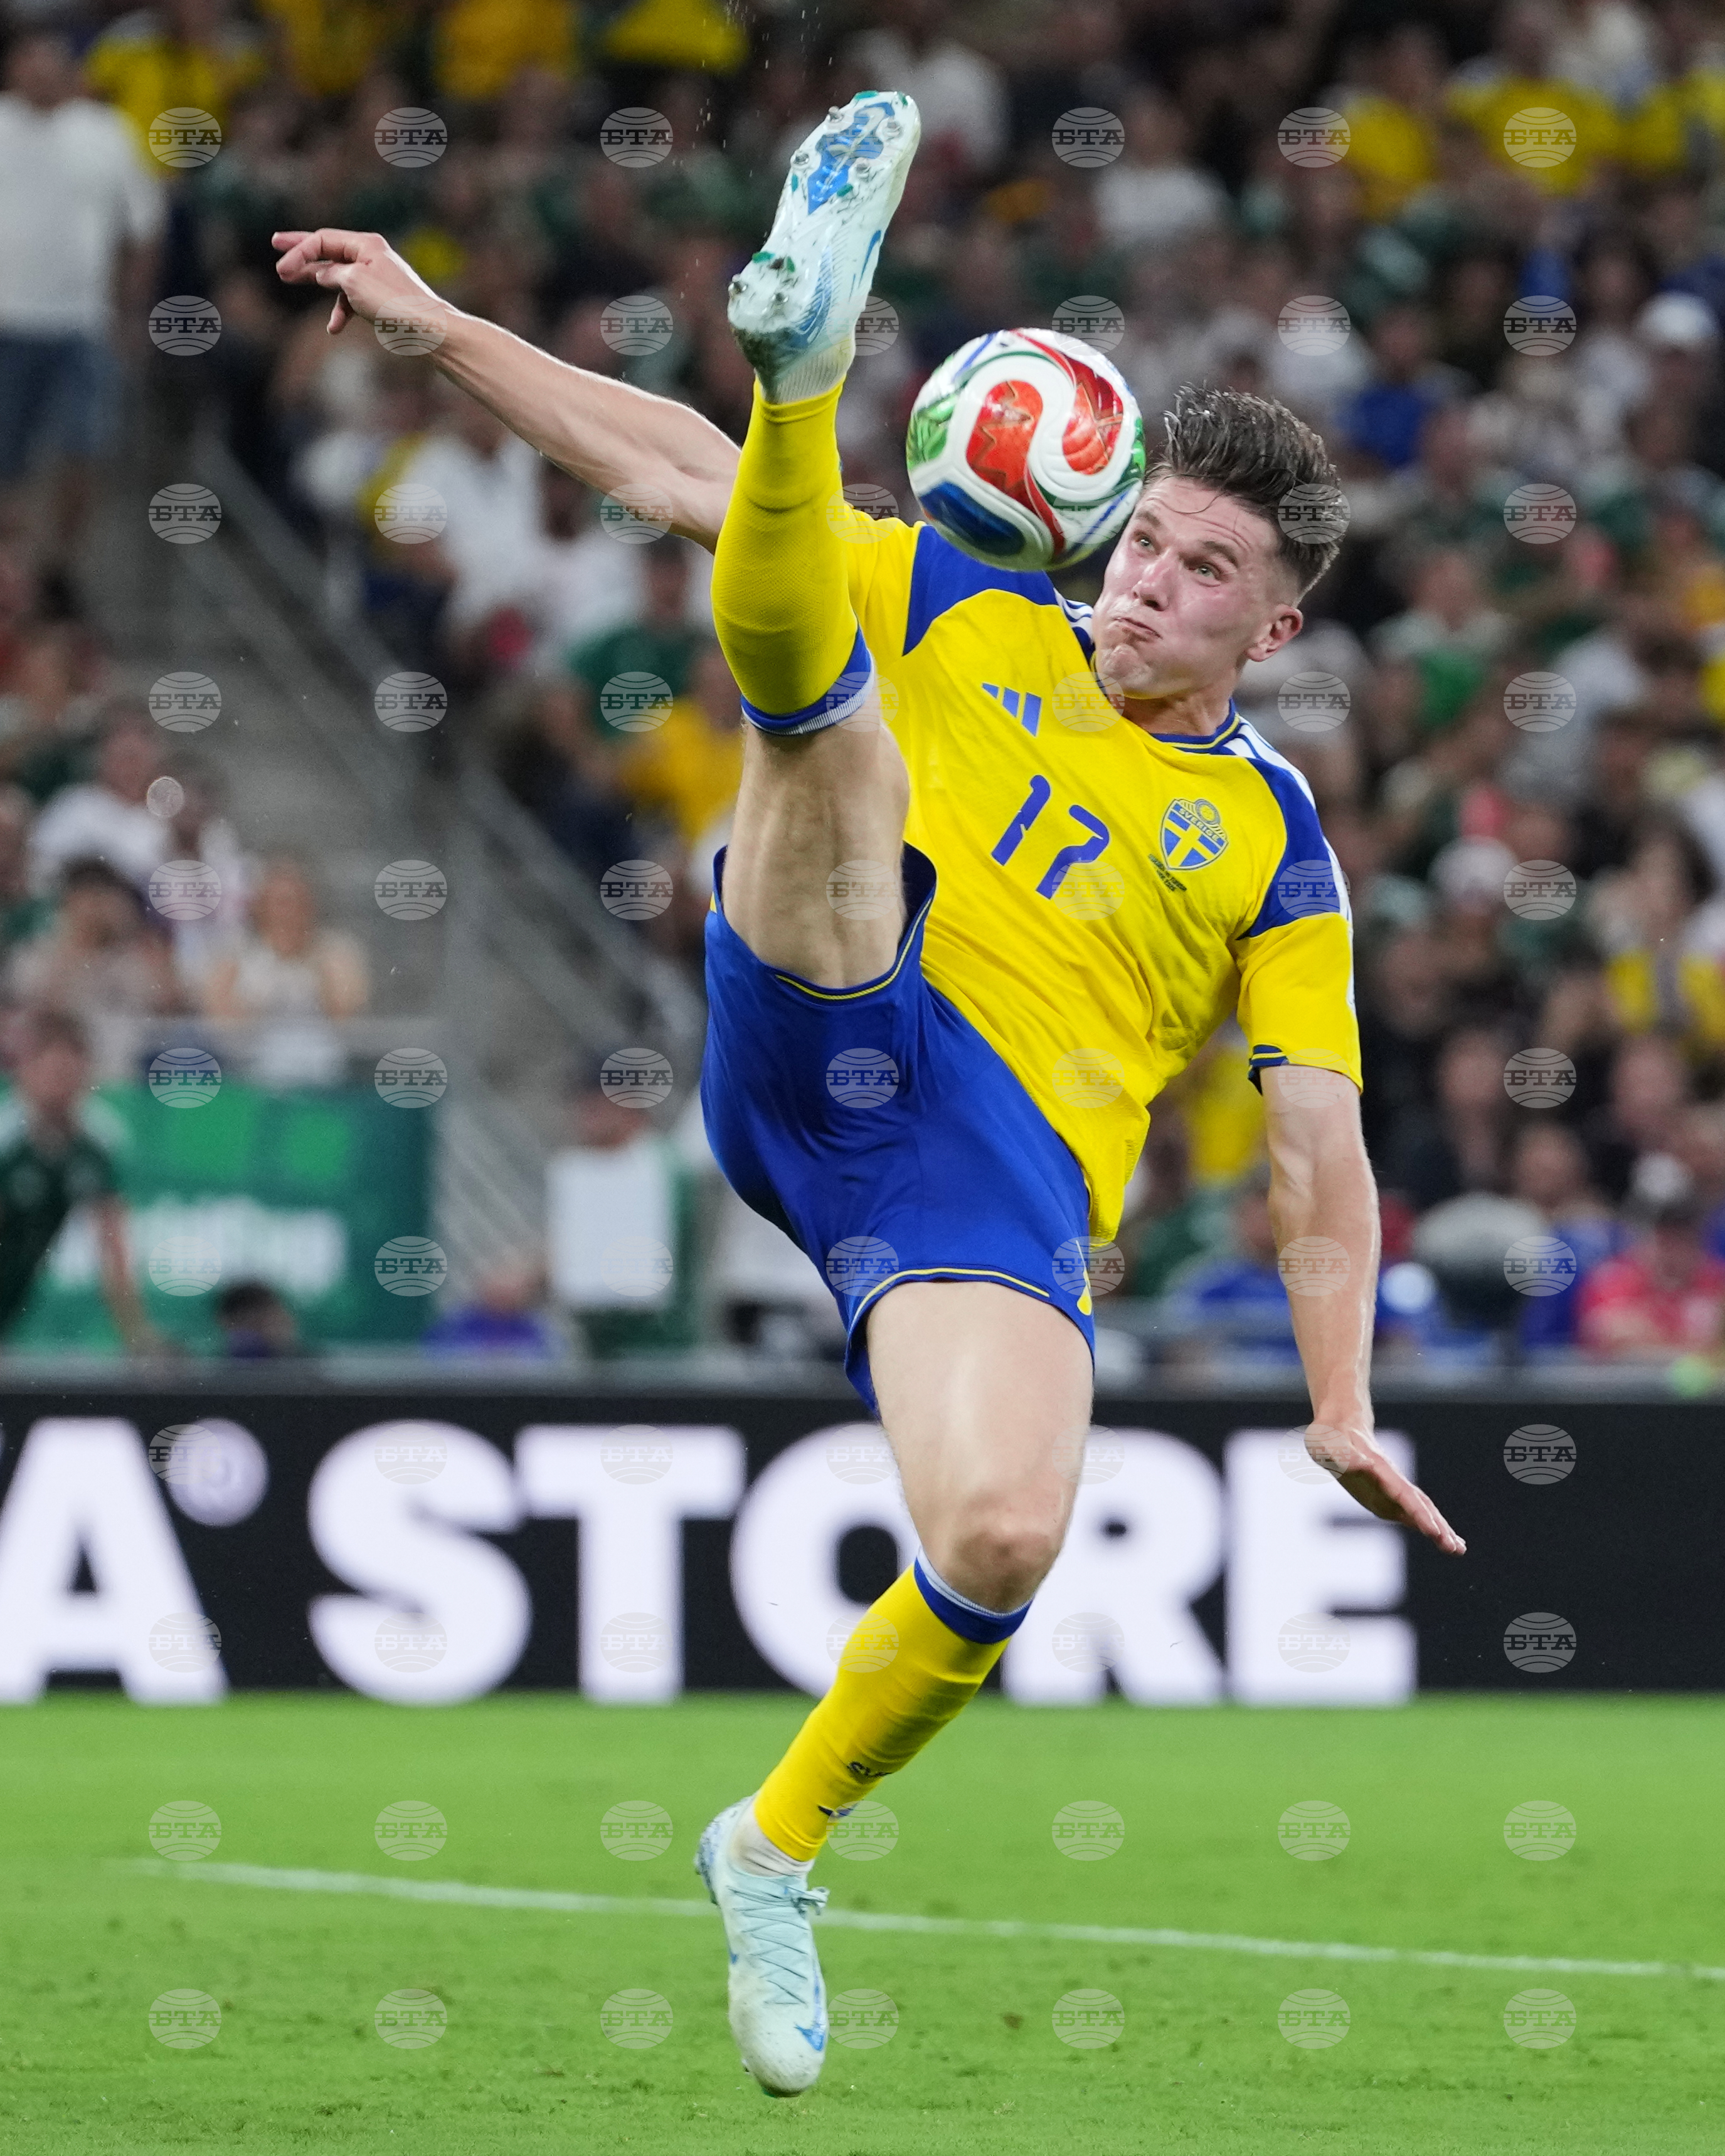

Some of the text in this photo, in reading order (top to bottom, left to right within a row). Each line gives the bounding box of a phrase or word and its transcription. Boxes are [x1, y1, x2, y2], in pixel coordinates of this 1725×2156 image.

[991, 774, 1110, 900] 17
[1179, 808, 1218, 842] SVERIGE
[307, 1419, 1416, 1706] STORE
